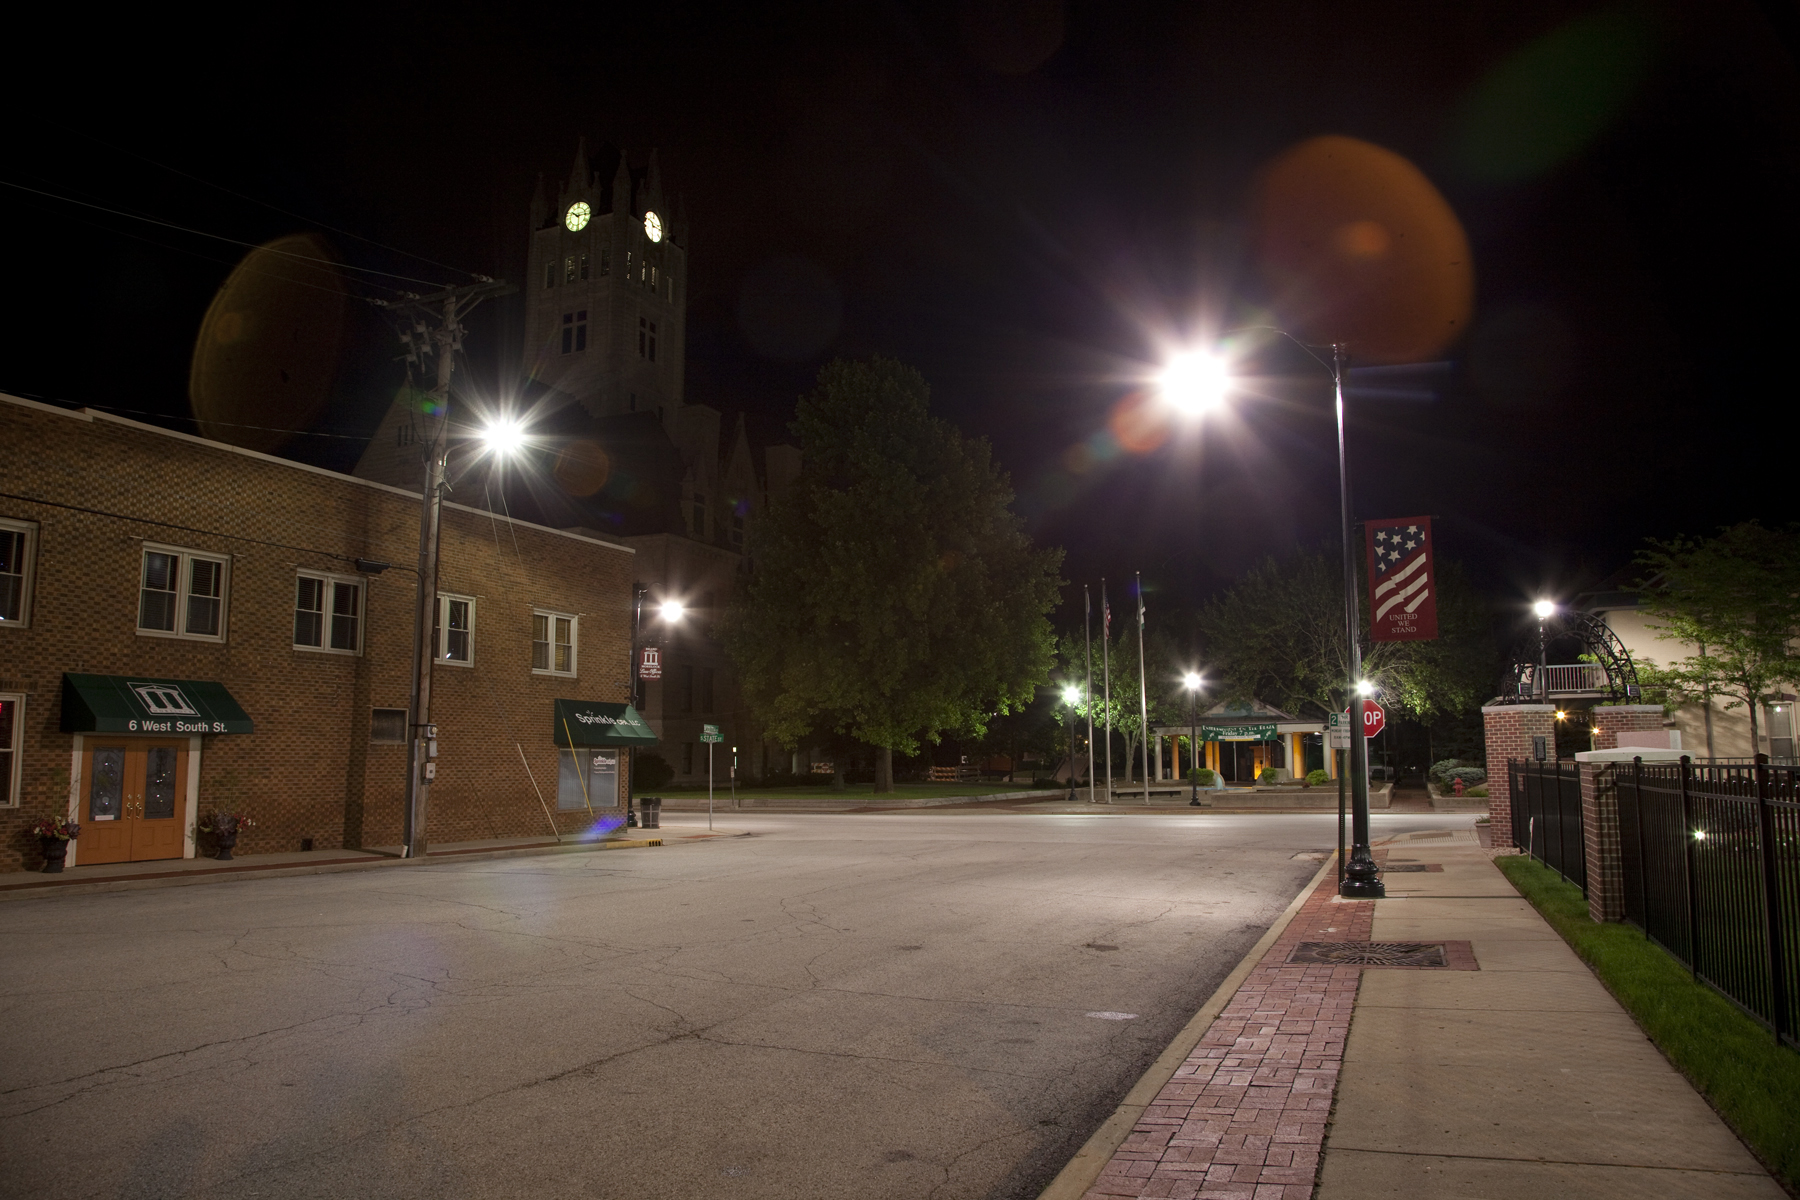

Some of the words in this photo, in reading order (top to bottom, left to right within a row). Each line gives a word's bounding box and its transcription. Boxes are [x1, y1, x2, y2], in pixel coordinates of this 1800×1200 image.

[575, 712, 616, 725] Sprinkle
[1331, 715, 1336, 724] 2
[128, 720, 138, 731] 6
[142, 720, 171, 732] West
[176, 721, 209, 732] South
[212, 722, 228, 732] St.
